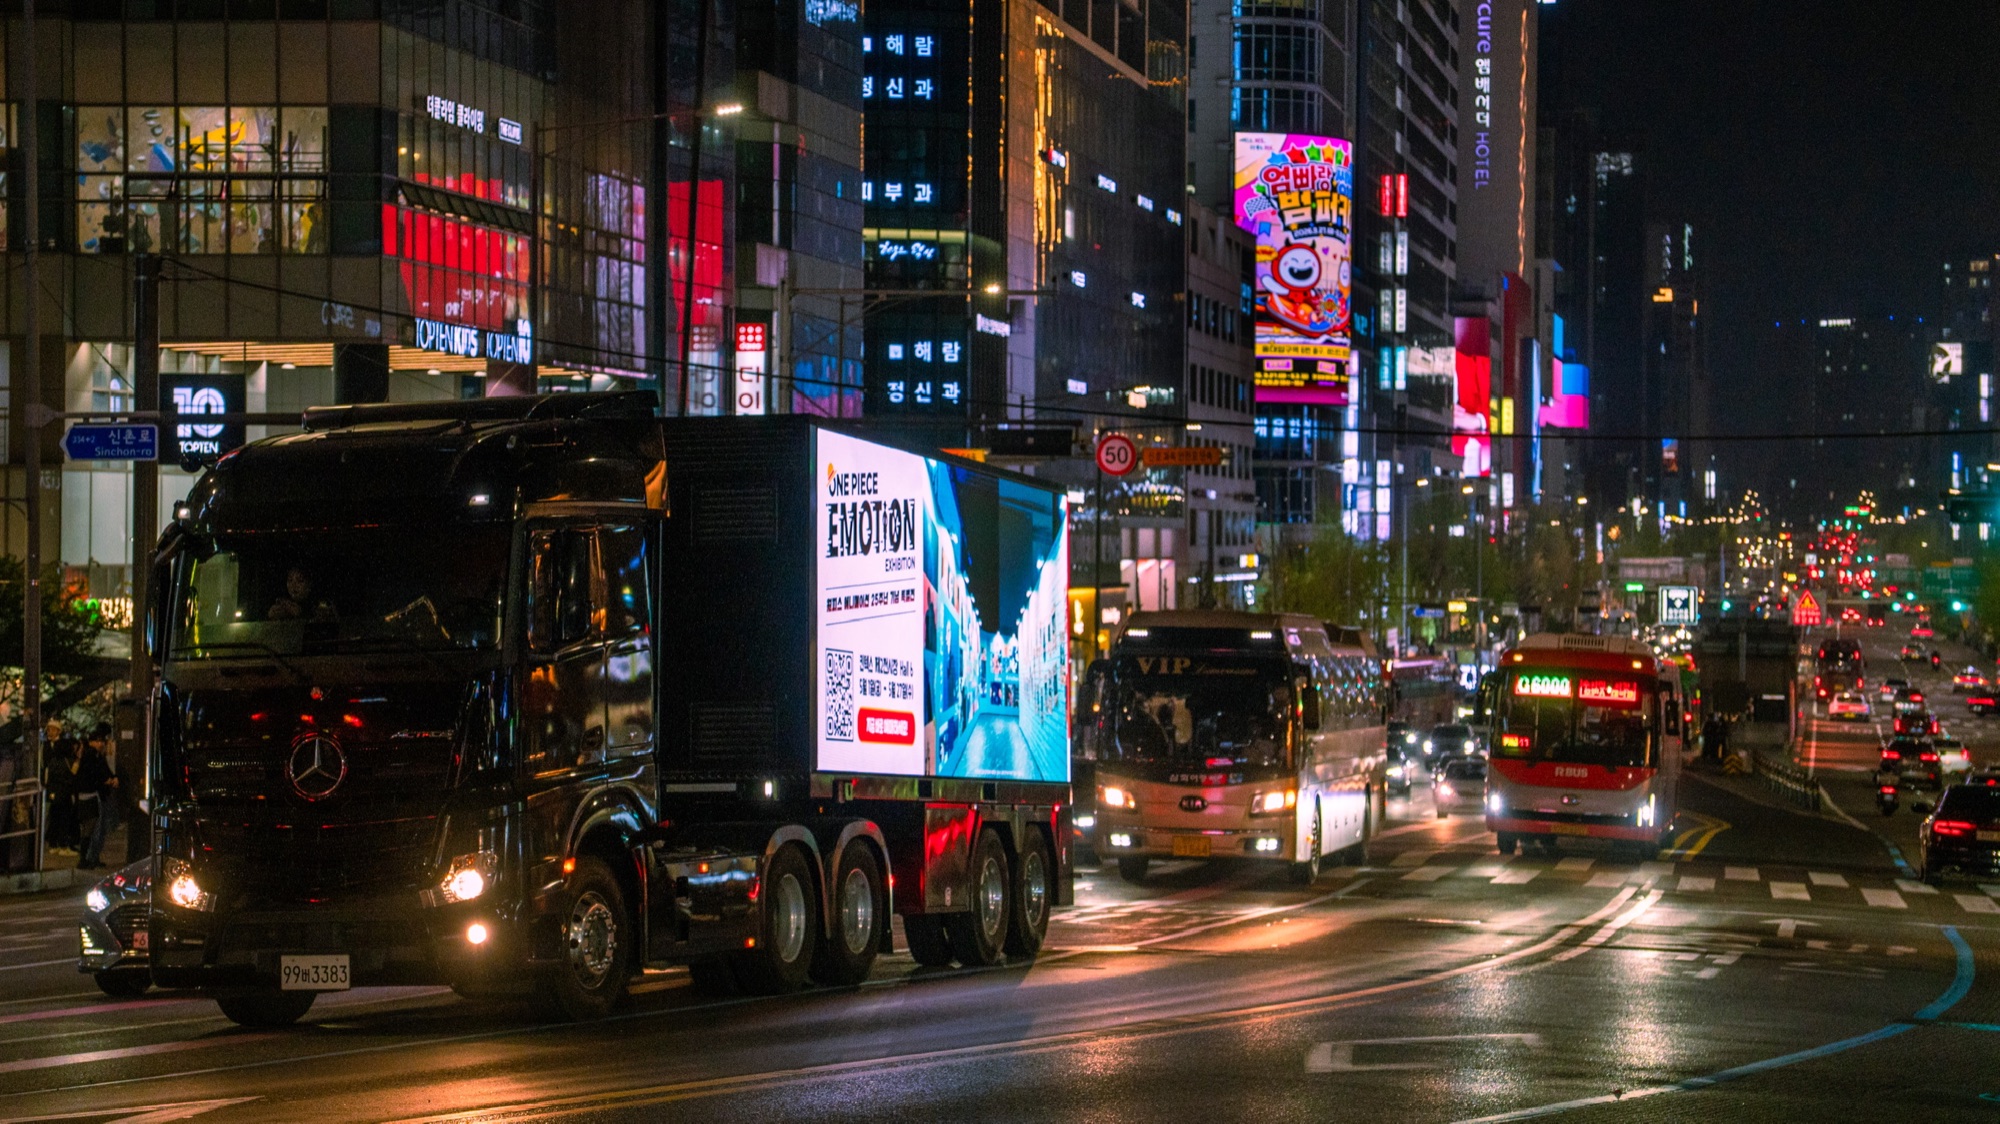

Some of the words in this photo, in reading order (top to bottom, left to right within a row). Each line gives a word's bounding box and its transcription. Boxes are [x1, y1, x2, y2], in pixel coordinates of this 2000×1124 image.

[1476, 0, 1492, 53] cure
[885, 34, 935, 57] 해람
[426, 95, 456, 125] 더클라임
[457, 103, 484, 134] 클라이밍
[1475, 132, 1490, 190] HOTEL
[914, 340, 962, 363] 해람
[887, 381, 961, 405] 정신과
[173, 387, 226, 438] 10
[108, 429, 152, 445] 신촌로
[178, 441, 220, 454] TOPTEN
[94, 446, 153, 457] Sinchon-ro
[1105, 446, 1129, 464] 50
[828, 474, 849, 497] ONE
[851, 472, 878, 496] PIECE
[825, 498, 915, 558] EMOTION
[885, 557, 916, 572] EXHIBITION
[1137, 657, 1191, 675] VIP
[283, 964, 348, 984] 99버3383
